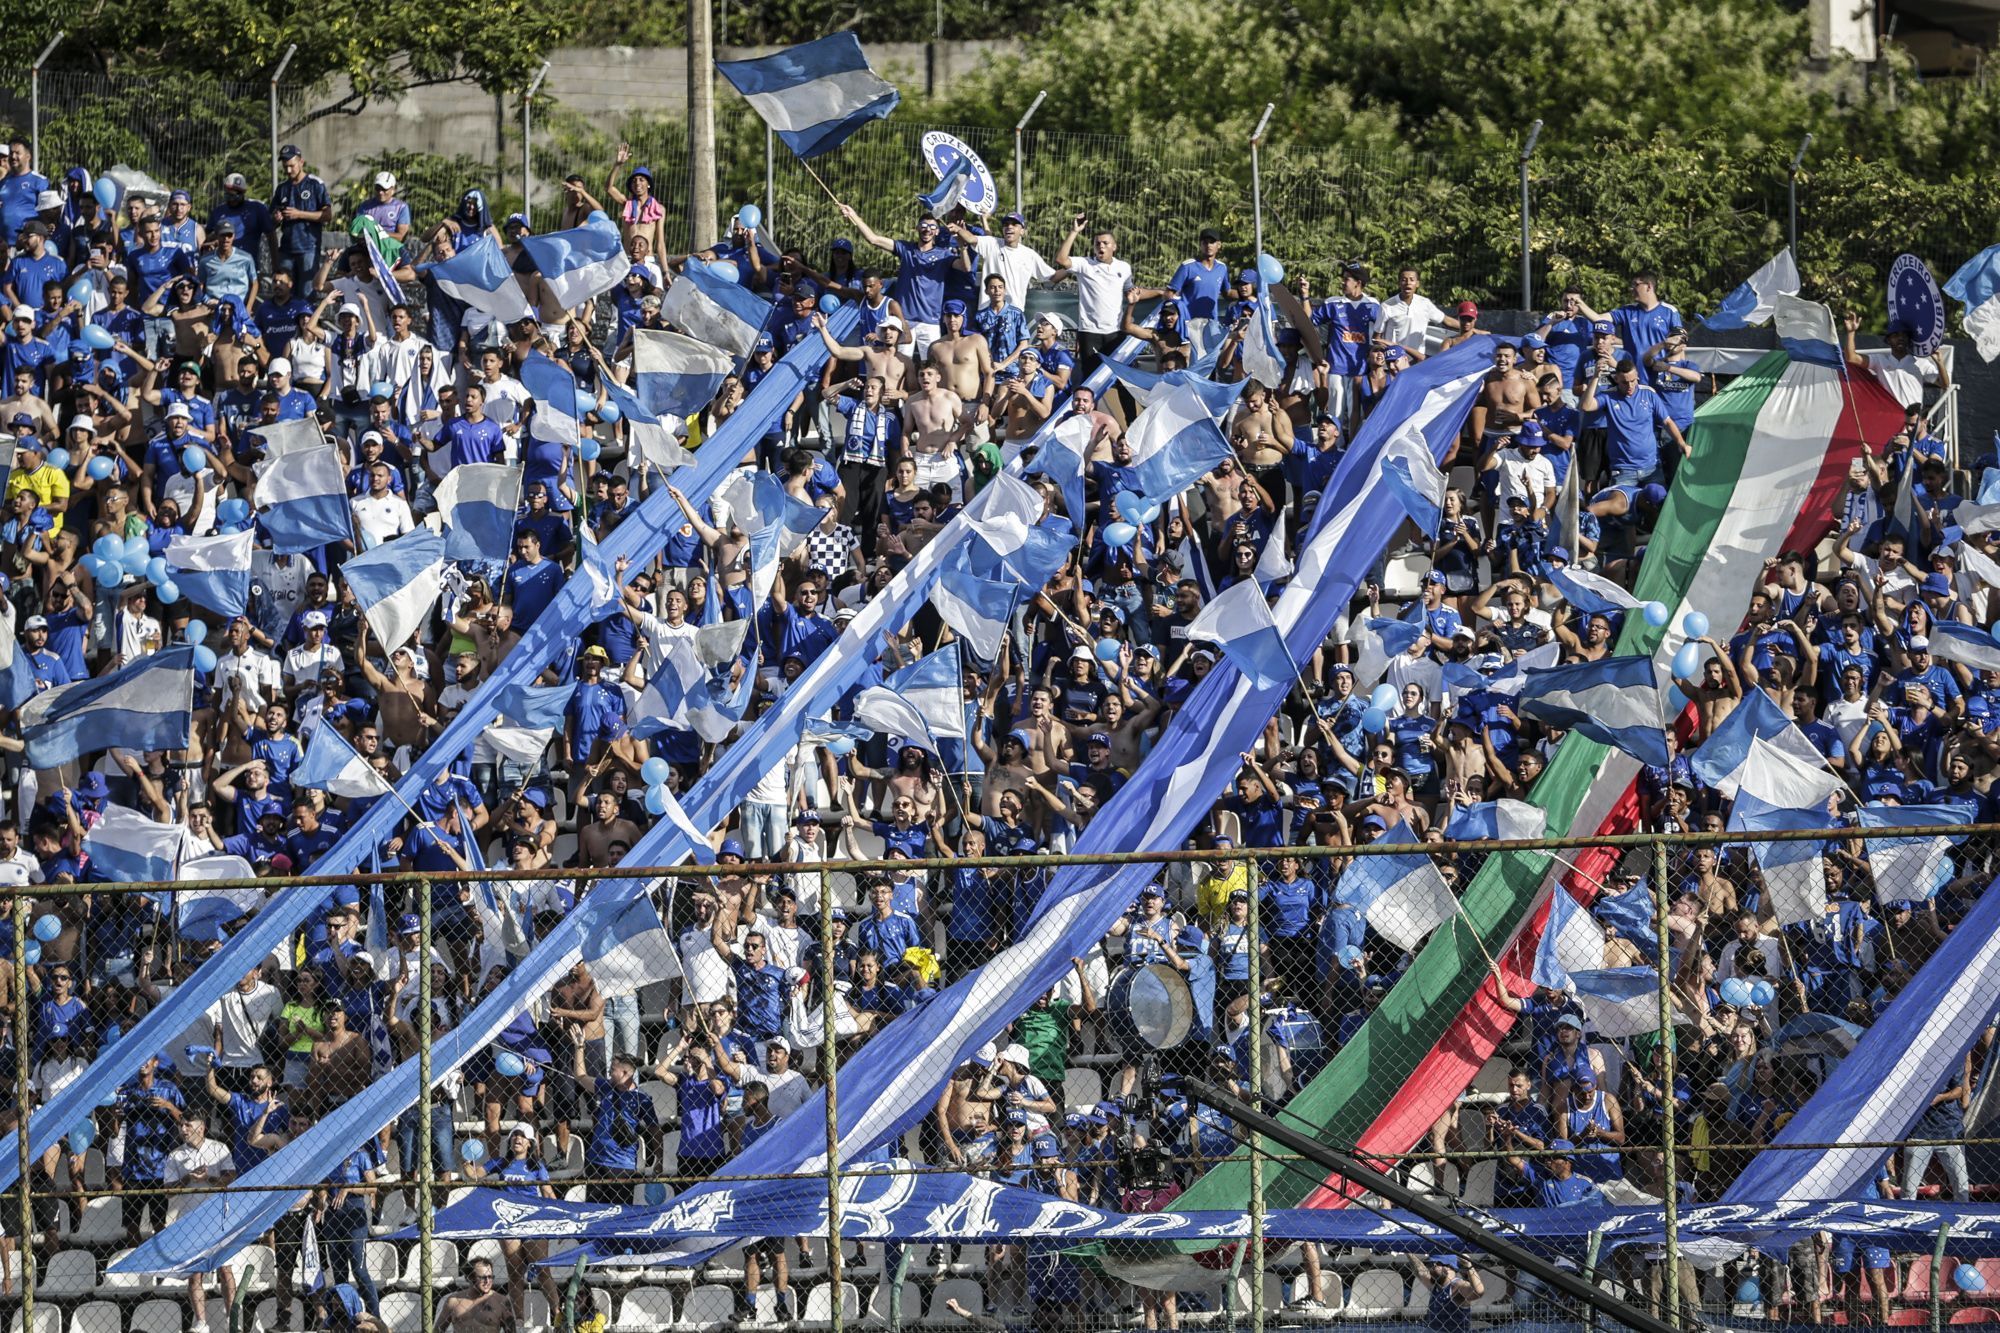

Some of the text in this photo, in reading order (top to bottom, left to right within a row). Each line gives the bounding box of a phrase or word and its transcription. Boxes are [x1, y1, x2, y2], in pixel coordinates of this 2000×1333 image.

[926, 133, 986, 174] CRUZEIRO
[1889, 256, 1931, 288] CRUZEIRO
[1930, 293, 1944, 350] CLUBE
[1091, 733, 1106, 742] TFC
[801, 810, 819, 818] TFC
[1008, 1111, 1024, 1120] TFC
[1035, 1140, 1049, 1150] TFC
